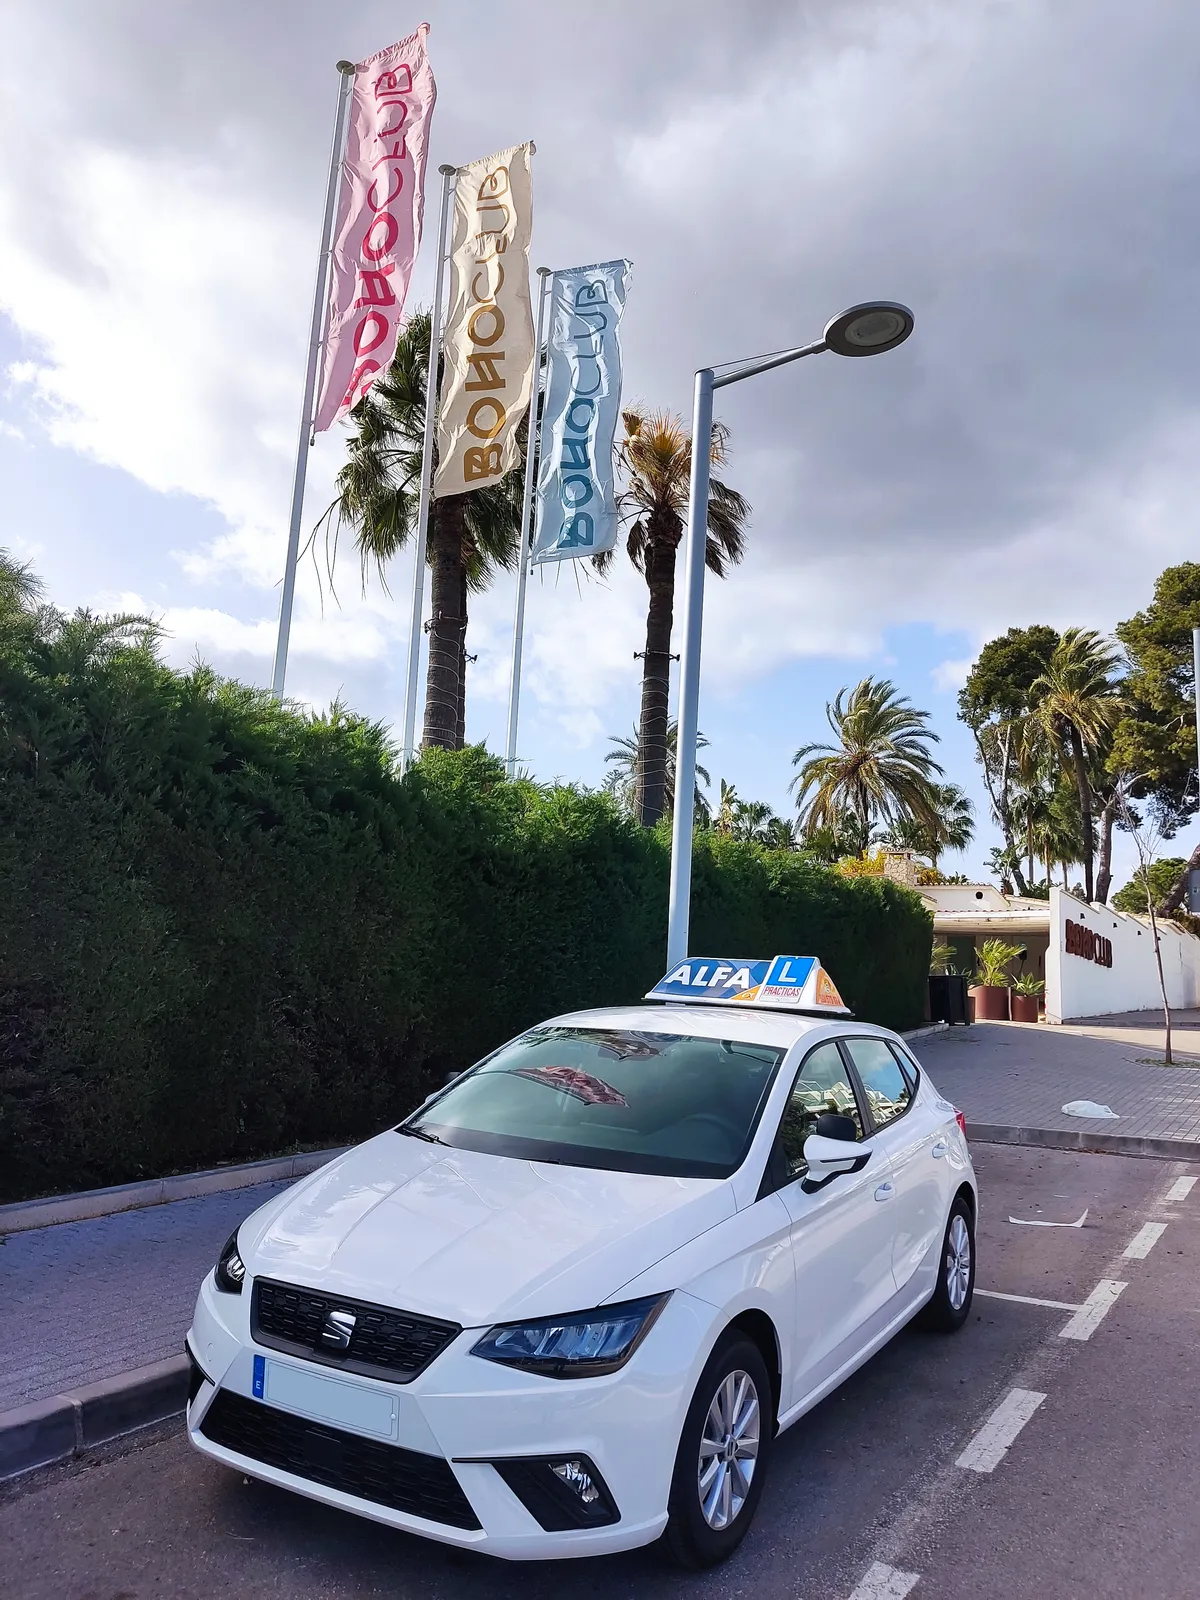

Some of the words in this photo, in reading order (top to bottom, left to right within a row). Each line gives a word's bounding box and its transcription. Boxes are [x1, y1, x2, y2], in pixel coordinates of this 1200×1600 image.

[664, 965, 750, 989] ALFA
[778, 961, 797, 983] L
[764, 986, 801, 997] PRACTICAS
[255, 1380, 261, 1389] E
